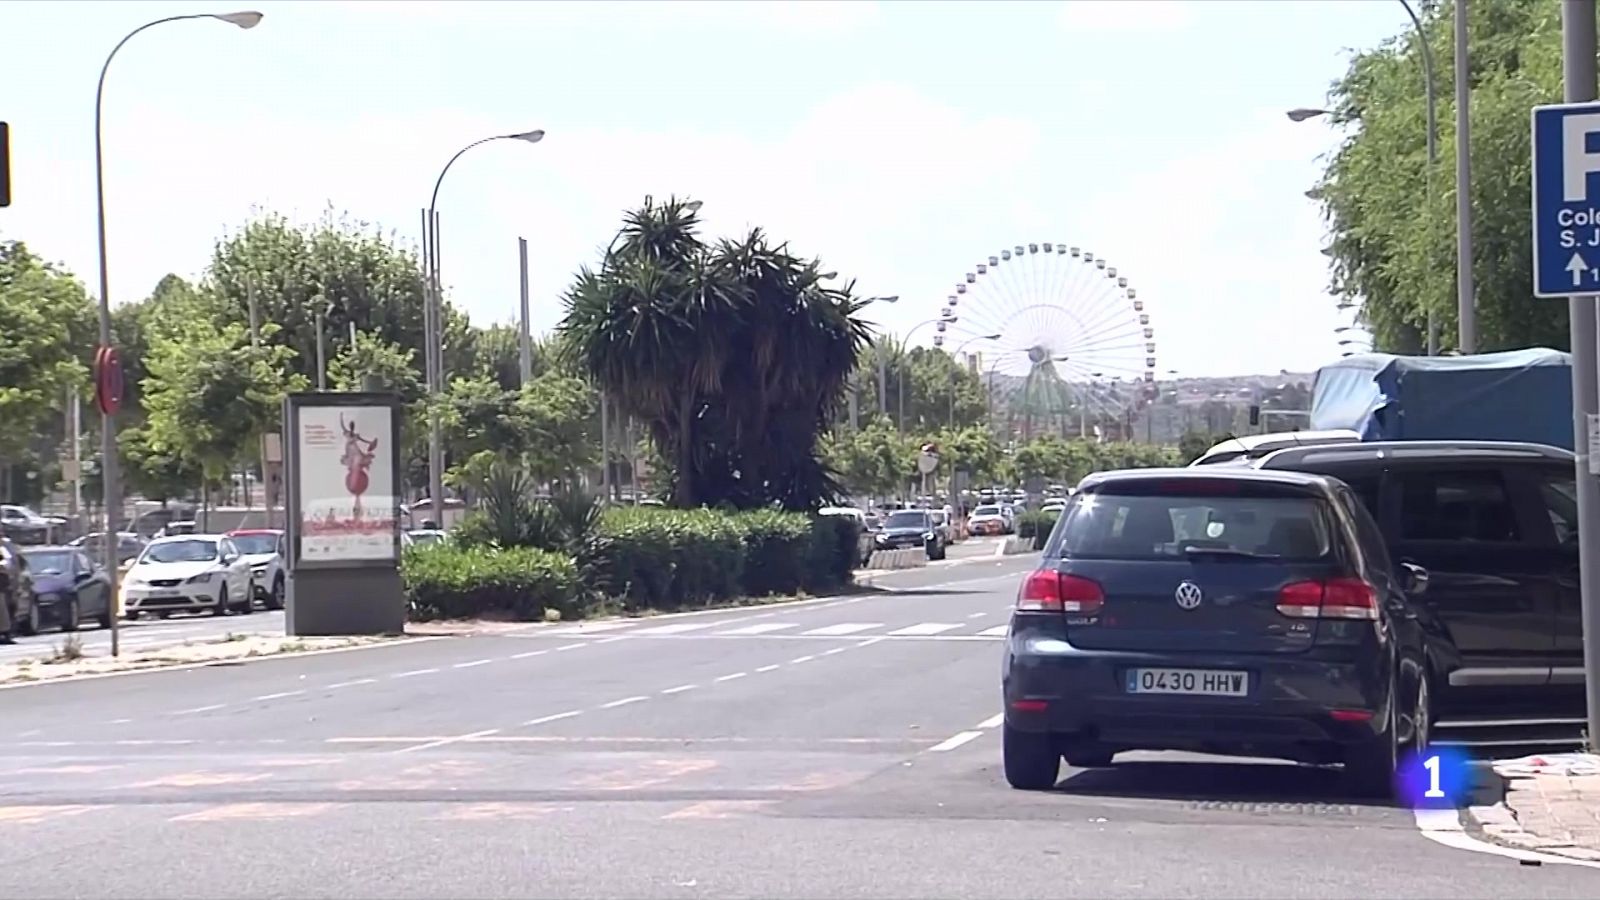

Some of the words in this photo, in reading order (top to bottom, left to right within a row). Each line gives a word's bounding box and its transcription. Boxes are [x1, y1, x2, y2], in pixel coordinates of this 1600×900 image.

[1560, 229, 1581, 248] S.
[1142, 671, 1196, 690] 0430
[1203, 673, 1243, 692] HHW
